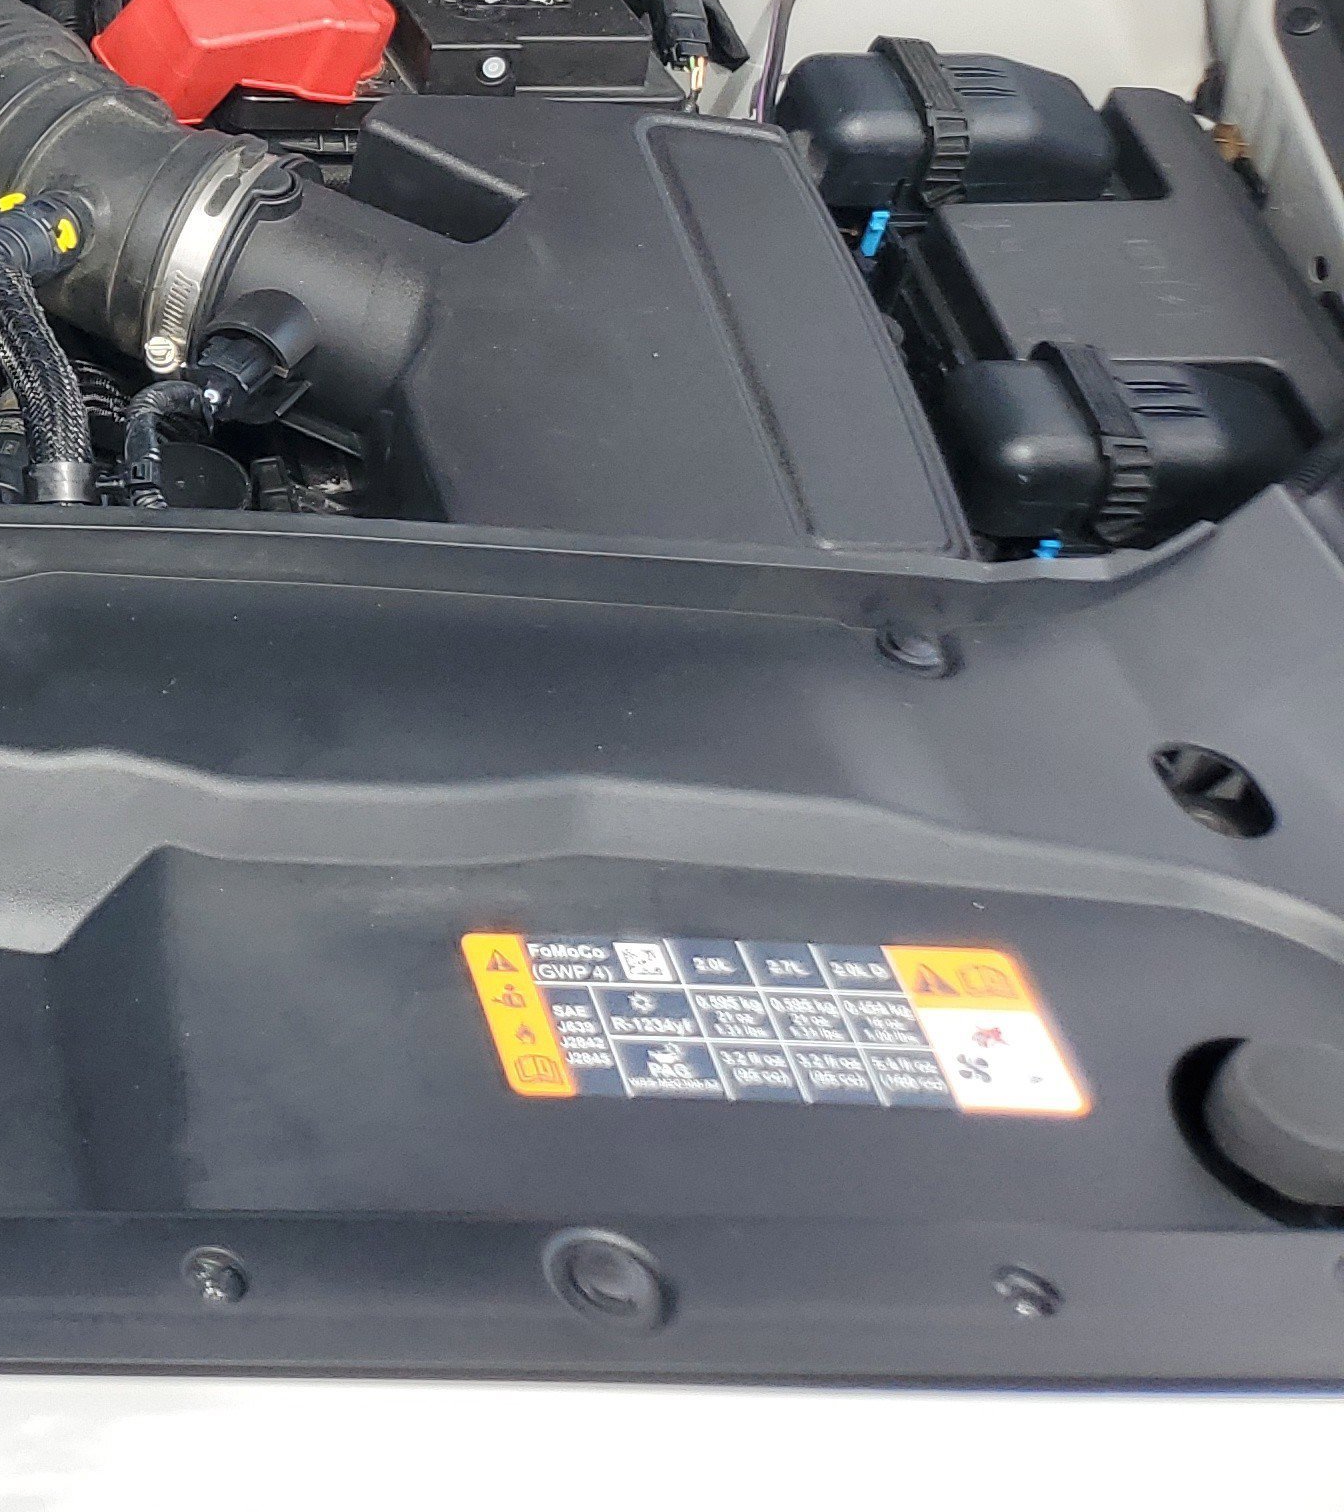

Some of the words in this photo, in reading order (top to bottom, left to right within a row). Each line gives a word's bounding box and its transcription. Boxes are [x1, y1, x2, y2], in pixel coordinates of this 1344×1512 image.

[526, 942, 606, 960] FoMoCo
[532, 962, 591, 981] (GWP
[592, 964, 613, 982] 4)
[692, 955, 736, 972] 2.0L
[552, 1004, 589, 1018] SAE
[557, 1020, 596, 1034] J639
[611, 1016, 695, 1036] R-1234yf
[560, 1035, 607, 1050] J2842
[647, 1061, 692, 1079] PAG
